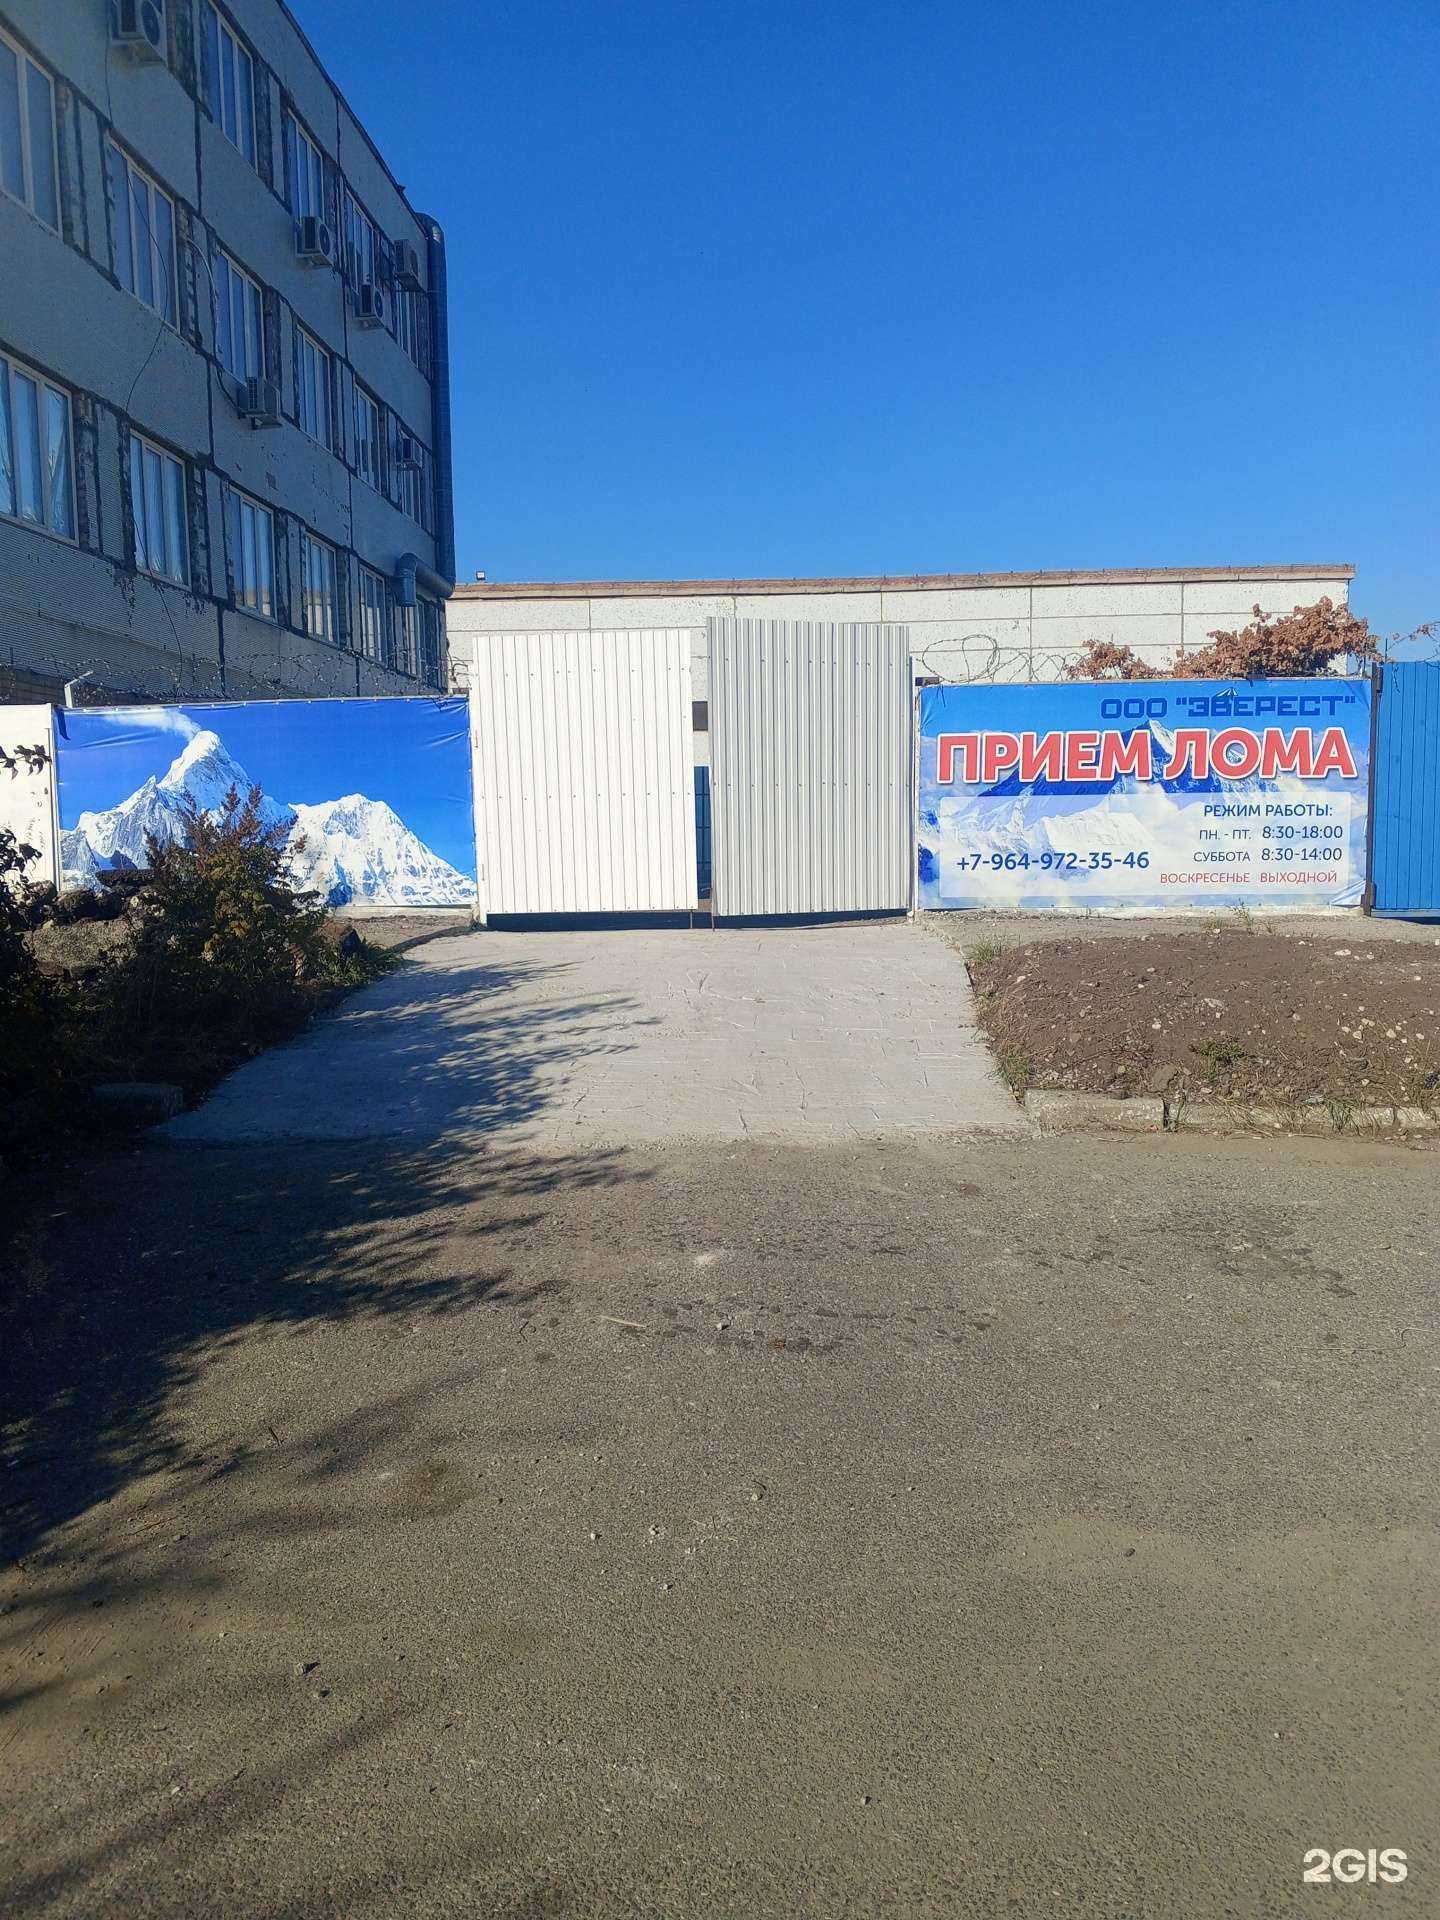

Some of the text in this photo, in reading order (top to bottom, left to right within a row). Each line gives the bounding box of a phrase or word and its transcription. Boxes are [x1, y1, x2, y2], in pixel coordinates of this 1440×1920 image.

[1101, 694, 1356, 719] ООО "ЭВЕРЕСТ"
[937, 727, 1359, 784] ПРИЕМ ЛОМА
[1204, 804, 1333, 817] РЕЖИМ РАБОТЫ:
[1199, 829, 1221, 840] ПН.
[1232, 829, 1252, 840] ПТ.
[1262, 825, 1343, 840] 8:30-18:00
[957, 852, 1150, 871] +7-964-972-35-46
[1193, 848, 1342, 862] СУББОТА 8:30-14:00
[1160, 869, 1337, 884] ВОСКРЕСЕНЬЕ ВЫХОДНОЙ
